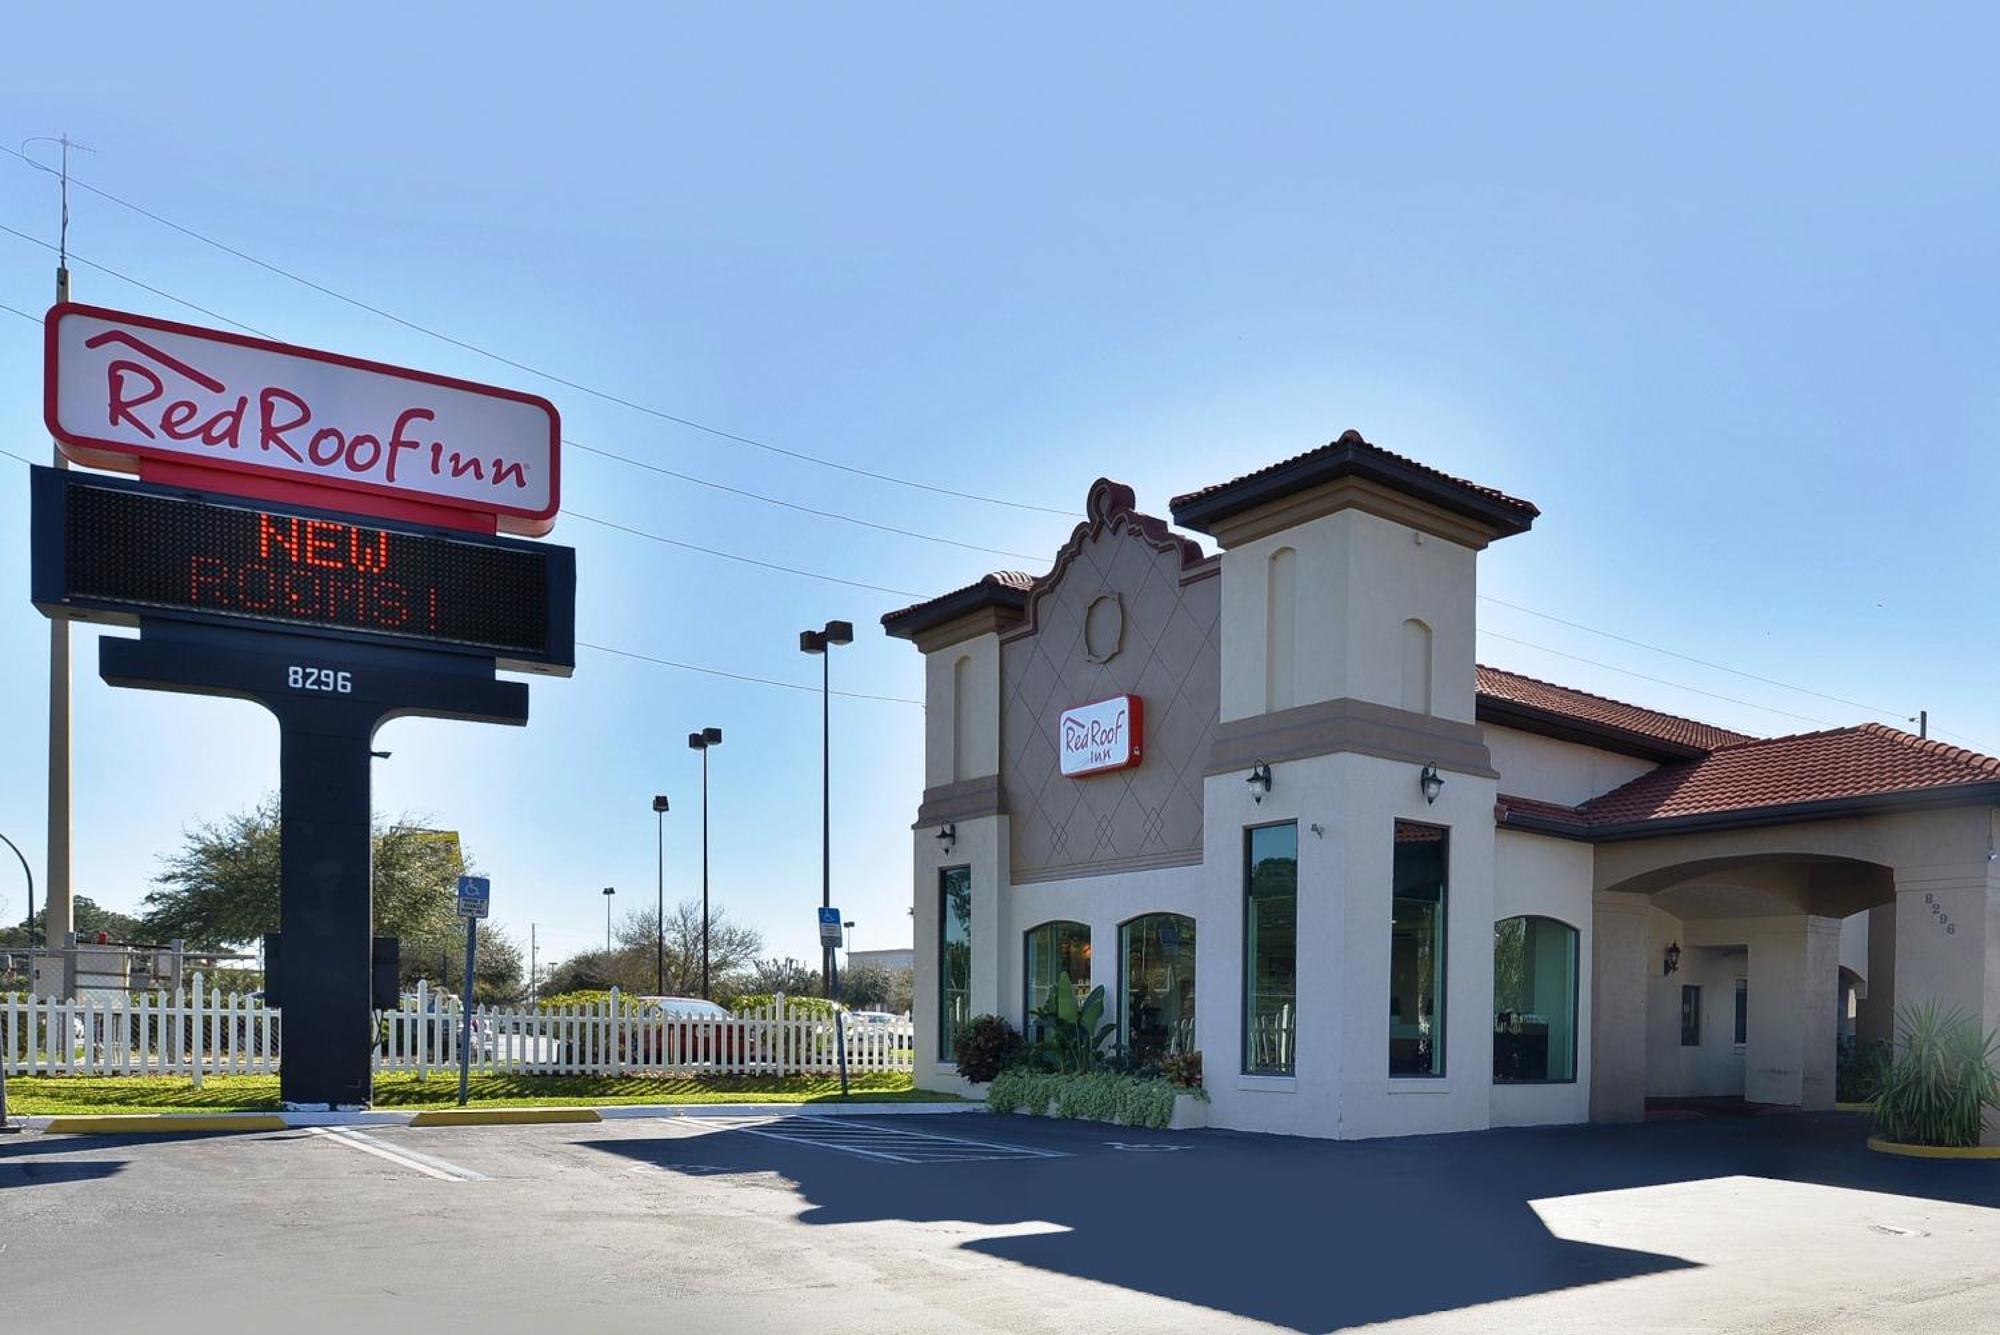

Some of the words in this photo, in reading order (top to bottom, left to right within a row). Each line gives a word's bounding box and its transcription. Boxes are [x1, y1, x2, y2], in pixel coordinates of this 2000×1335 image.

[107, 360, 248, 449] Red
[259, 387, 435, 483] Roof
[259, 512, 390, 574] NEW
[288, 666, 352, 693] 8296
[1065, 726, 1090, 753] Red
[1090, 709, 1126, 747] Roof
[1925, 893, 1955, 935] 8296
